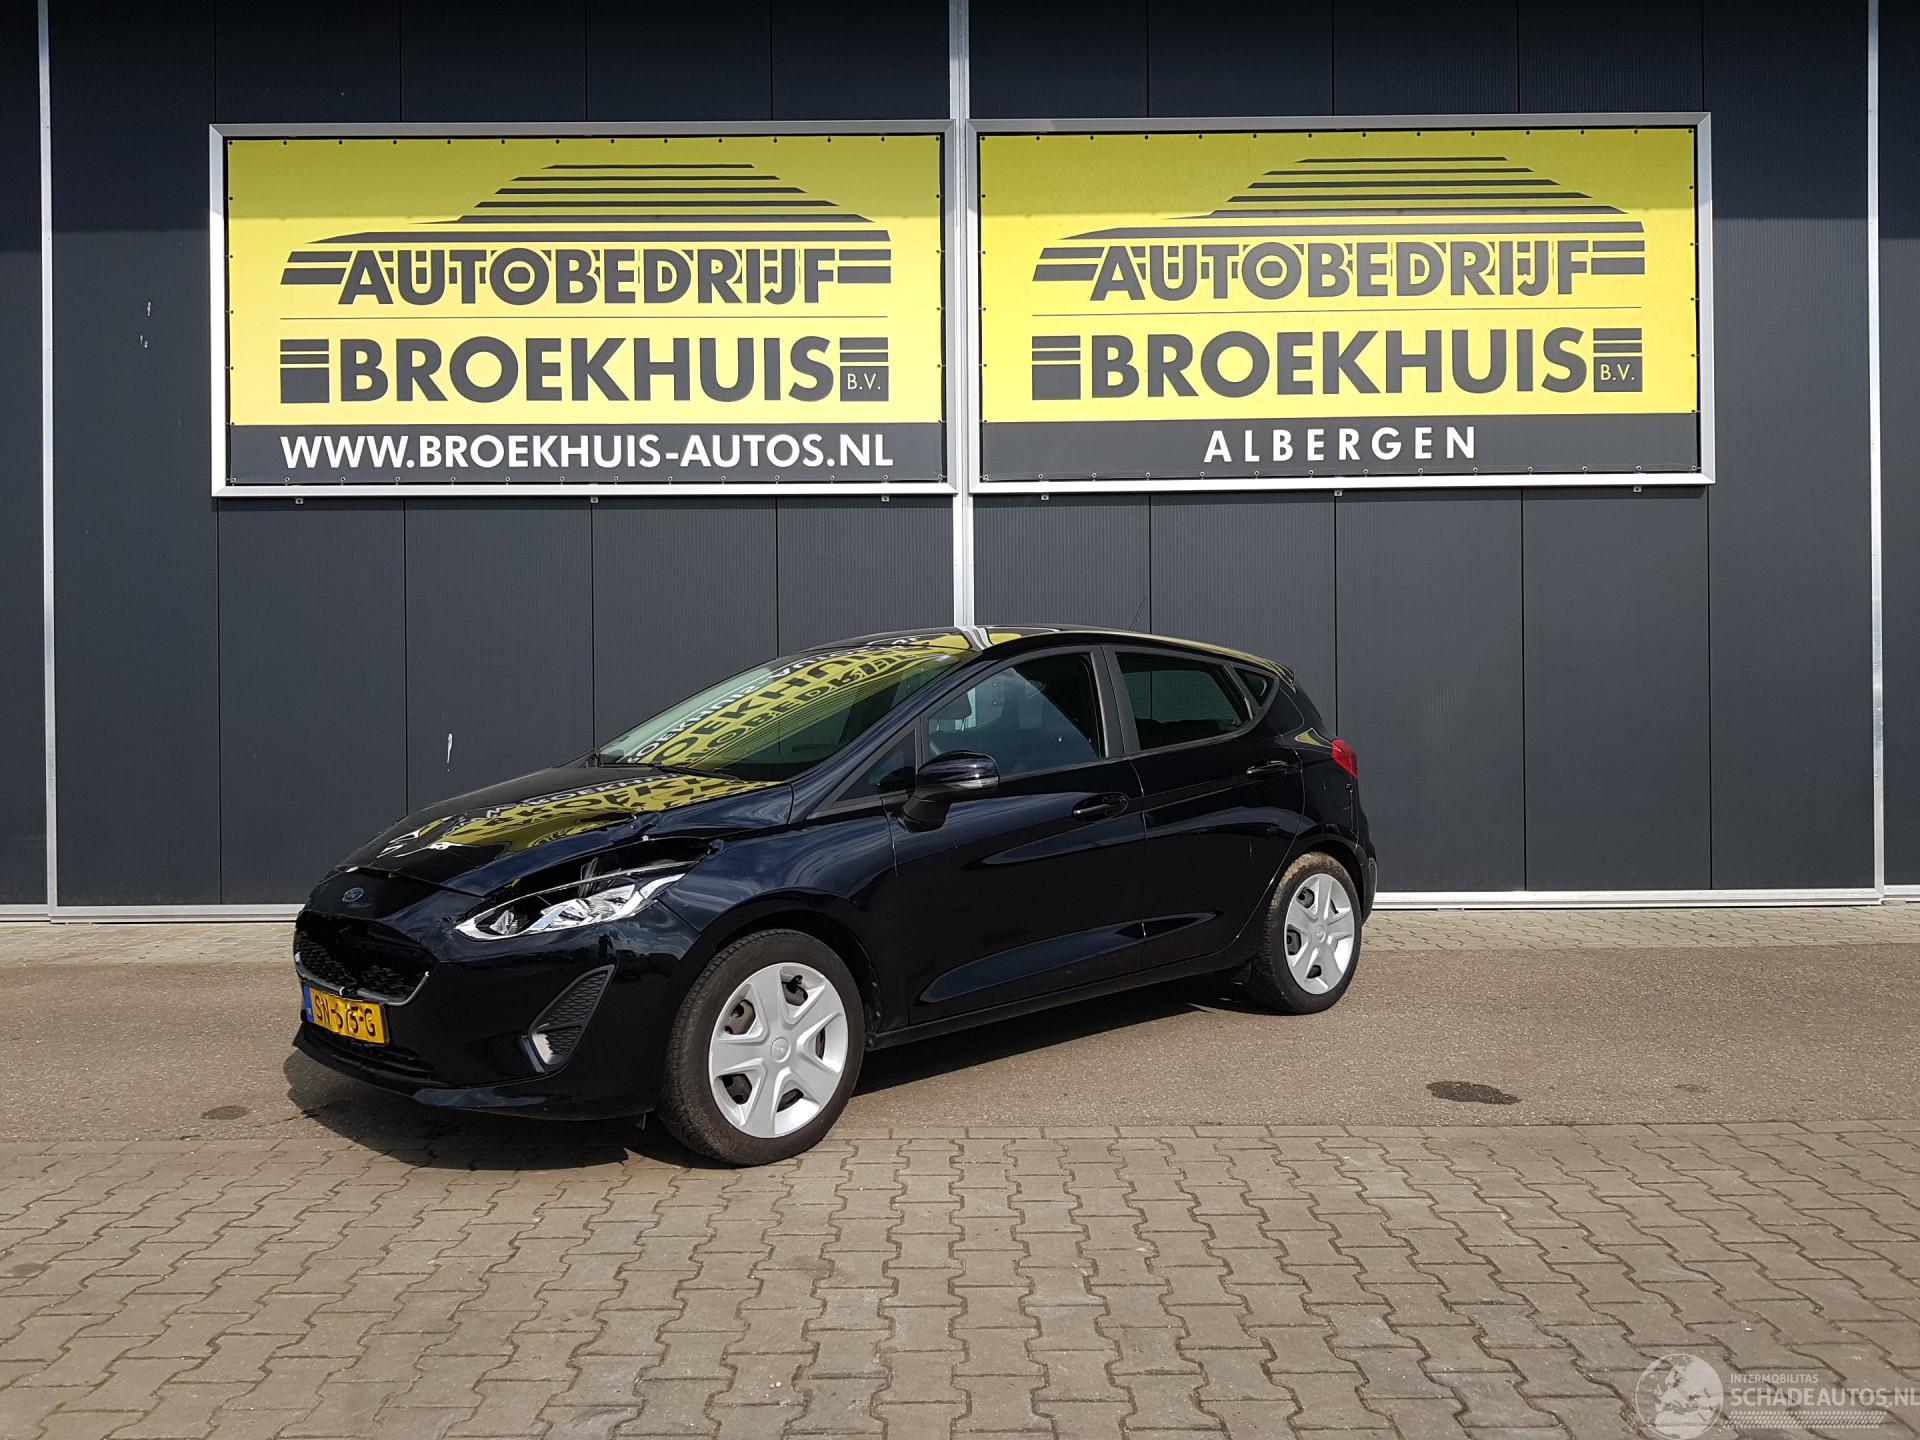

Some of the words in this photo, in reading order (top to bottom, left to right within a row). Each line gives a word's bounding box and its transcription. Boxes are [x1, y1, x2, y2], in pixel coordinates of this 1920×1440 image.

[338, 247, 837, 305] AUTOBEDRIJF
[1089, 240, 1590, 301] AUTOBEDRIJF
[340, 336, 834, 403] BROEKHUIS
[847, 373, 881, 390] B.V.
[1091, 327, 1588, 398] BROEKHUIS
[1600, 364, 1635, 381] B.V.
[280, 434, 894, 470] WWW.BROEKHUIS-AUTOS.NL
[1203, 426, 1476, 463] ALBERGEN
